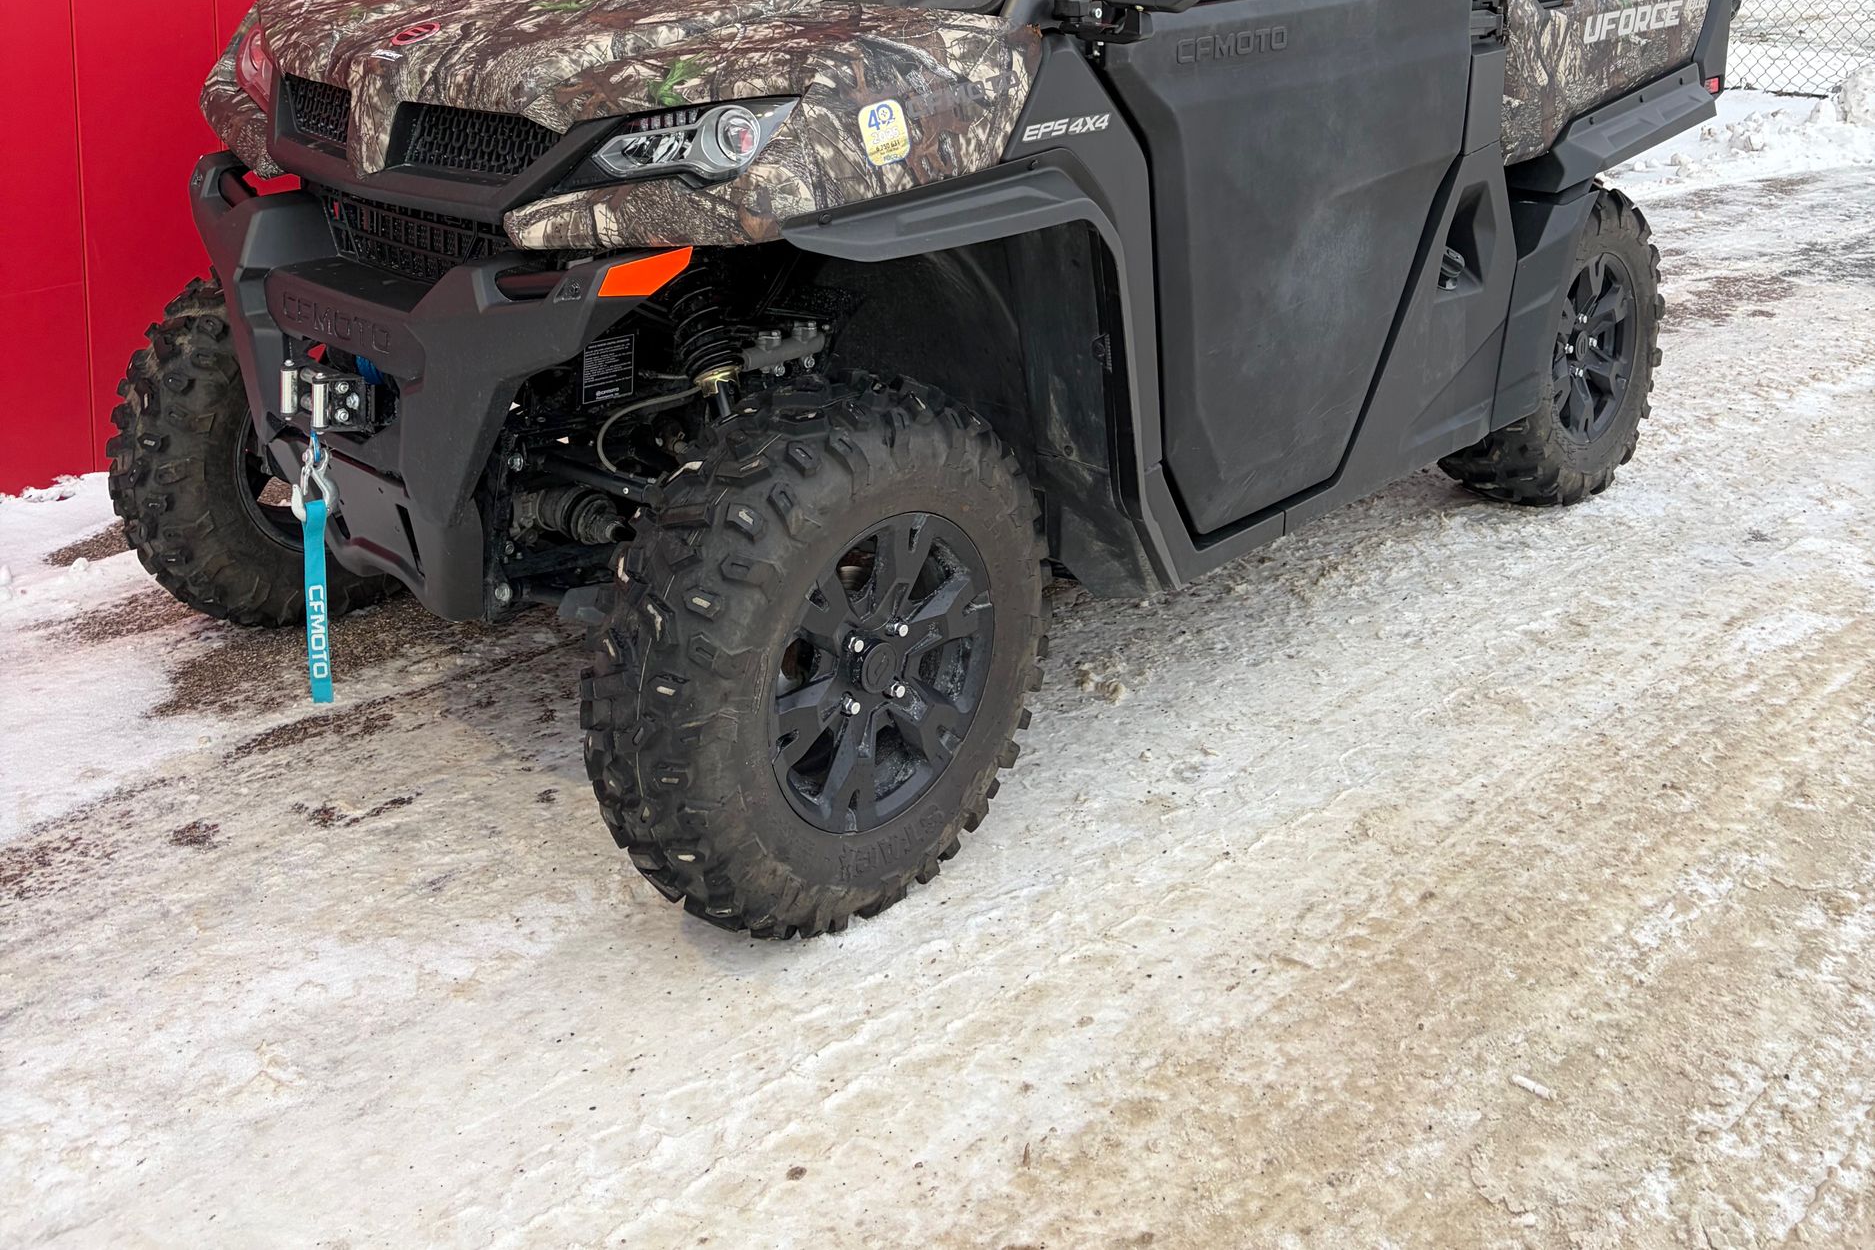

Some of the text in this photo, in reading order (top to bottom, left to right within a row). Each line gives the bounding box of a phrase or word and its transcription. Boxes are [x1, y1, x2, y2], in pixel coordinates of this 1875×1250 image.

[1583, 0, 1684, 44] UFORCE
[1177, 25, 1288, 64] CFMOTO
[1022, 113, 1110, 142] EPS 4X4
[282, 291, 390, 355] CFMOTO
[308, 584, 329, 679] CFMOTO
